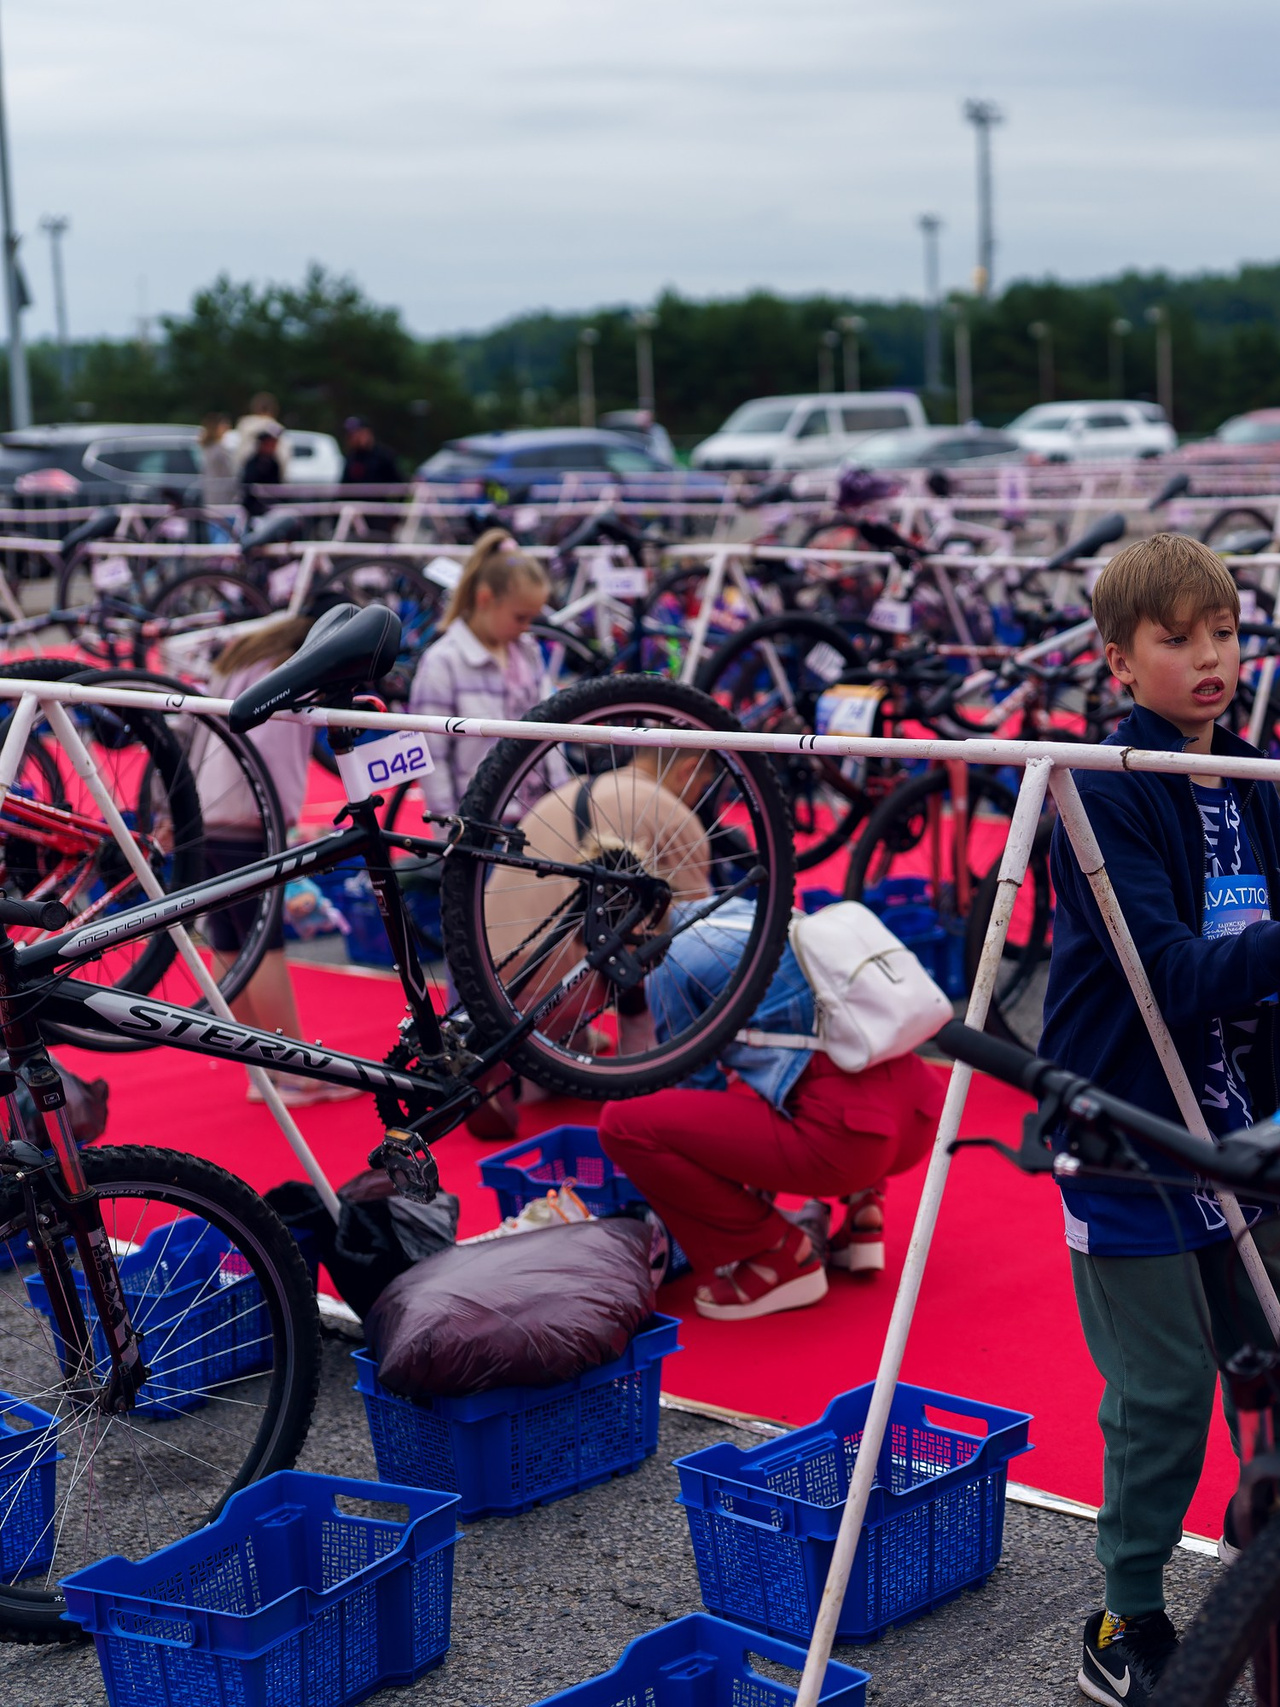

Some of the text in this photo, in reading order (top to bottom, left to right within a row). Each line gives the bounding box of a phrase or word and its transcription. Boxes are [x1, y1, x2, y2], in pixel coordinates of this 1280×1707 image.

[260, 688, 291, 712] STERN
[367, 746, 427, 783] 042
[1203, 887, 1269, 911] ДУАТЛО
[117, 1004, 334, 1070] STERN
